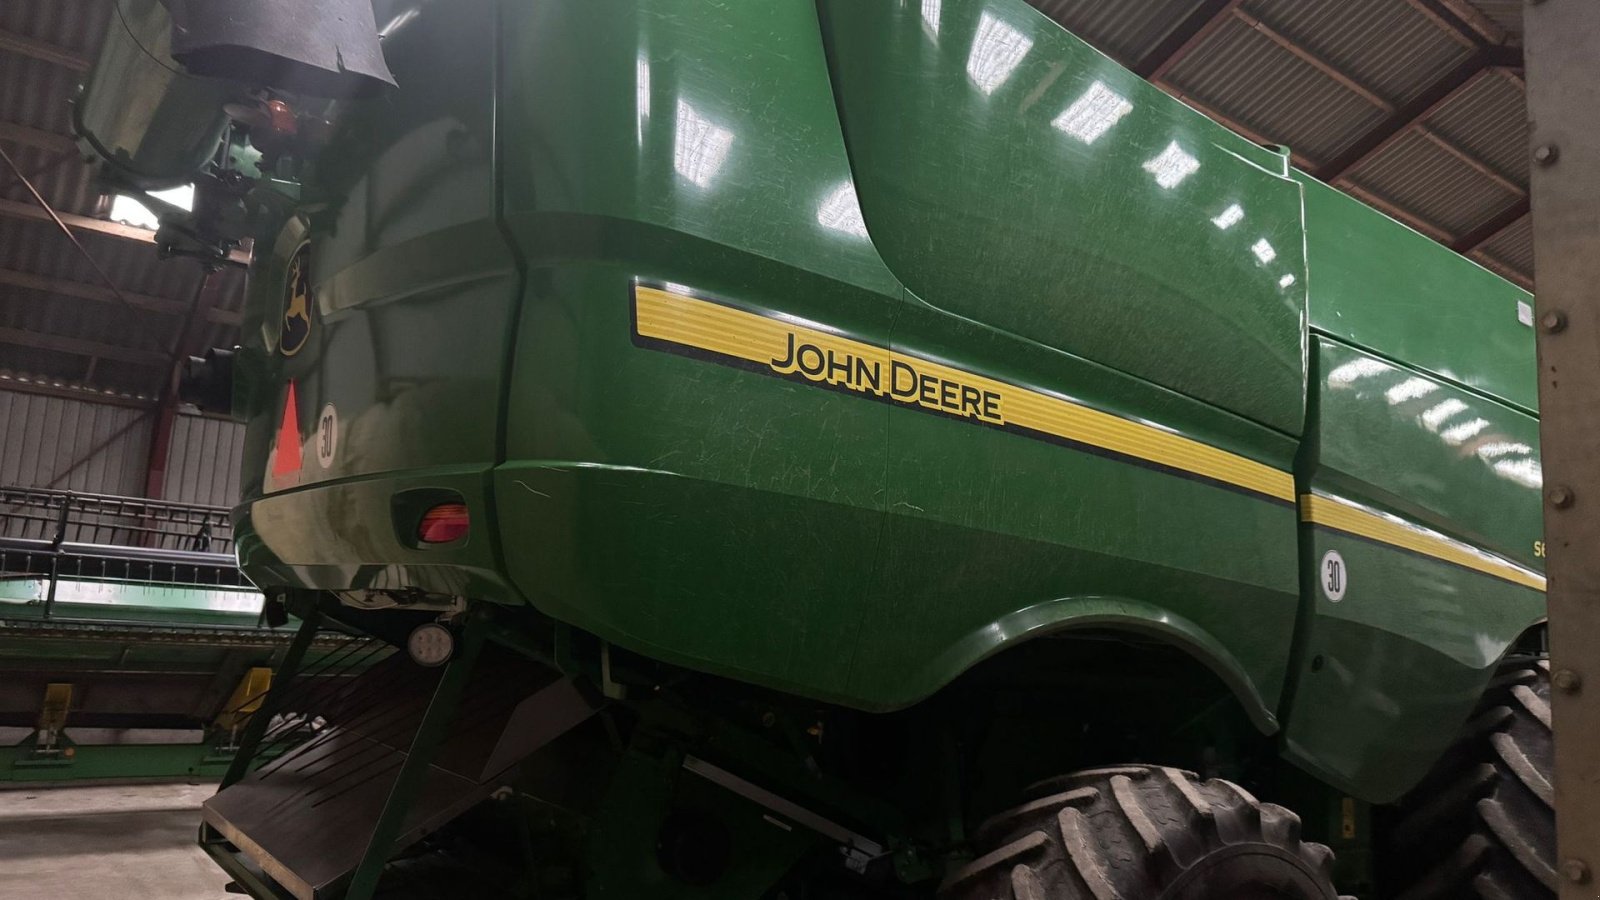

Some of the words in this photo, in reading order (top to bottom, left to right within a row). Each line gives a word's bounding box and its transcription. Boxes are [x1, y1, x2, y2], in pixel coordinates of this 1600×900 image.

[770, 332, 880, 392] JOHN
[891, 360, 1002, 420] DEERE
[320, 414, 333, 459] 30
[1327, 559, 1341, 593] 30
